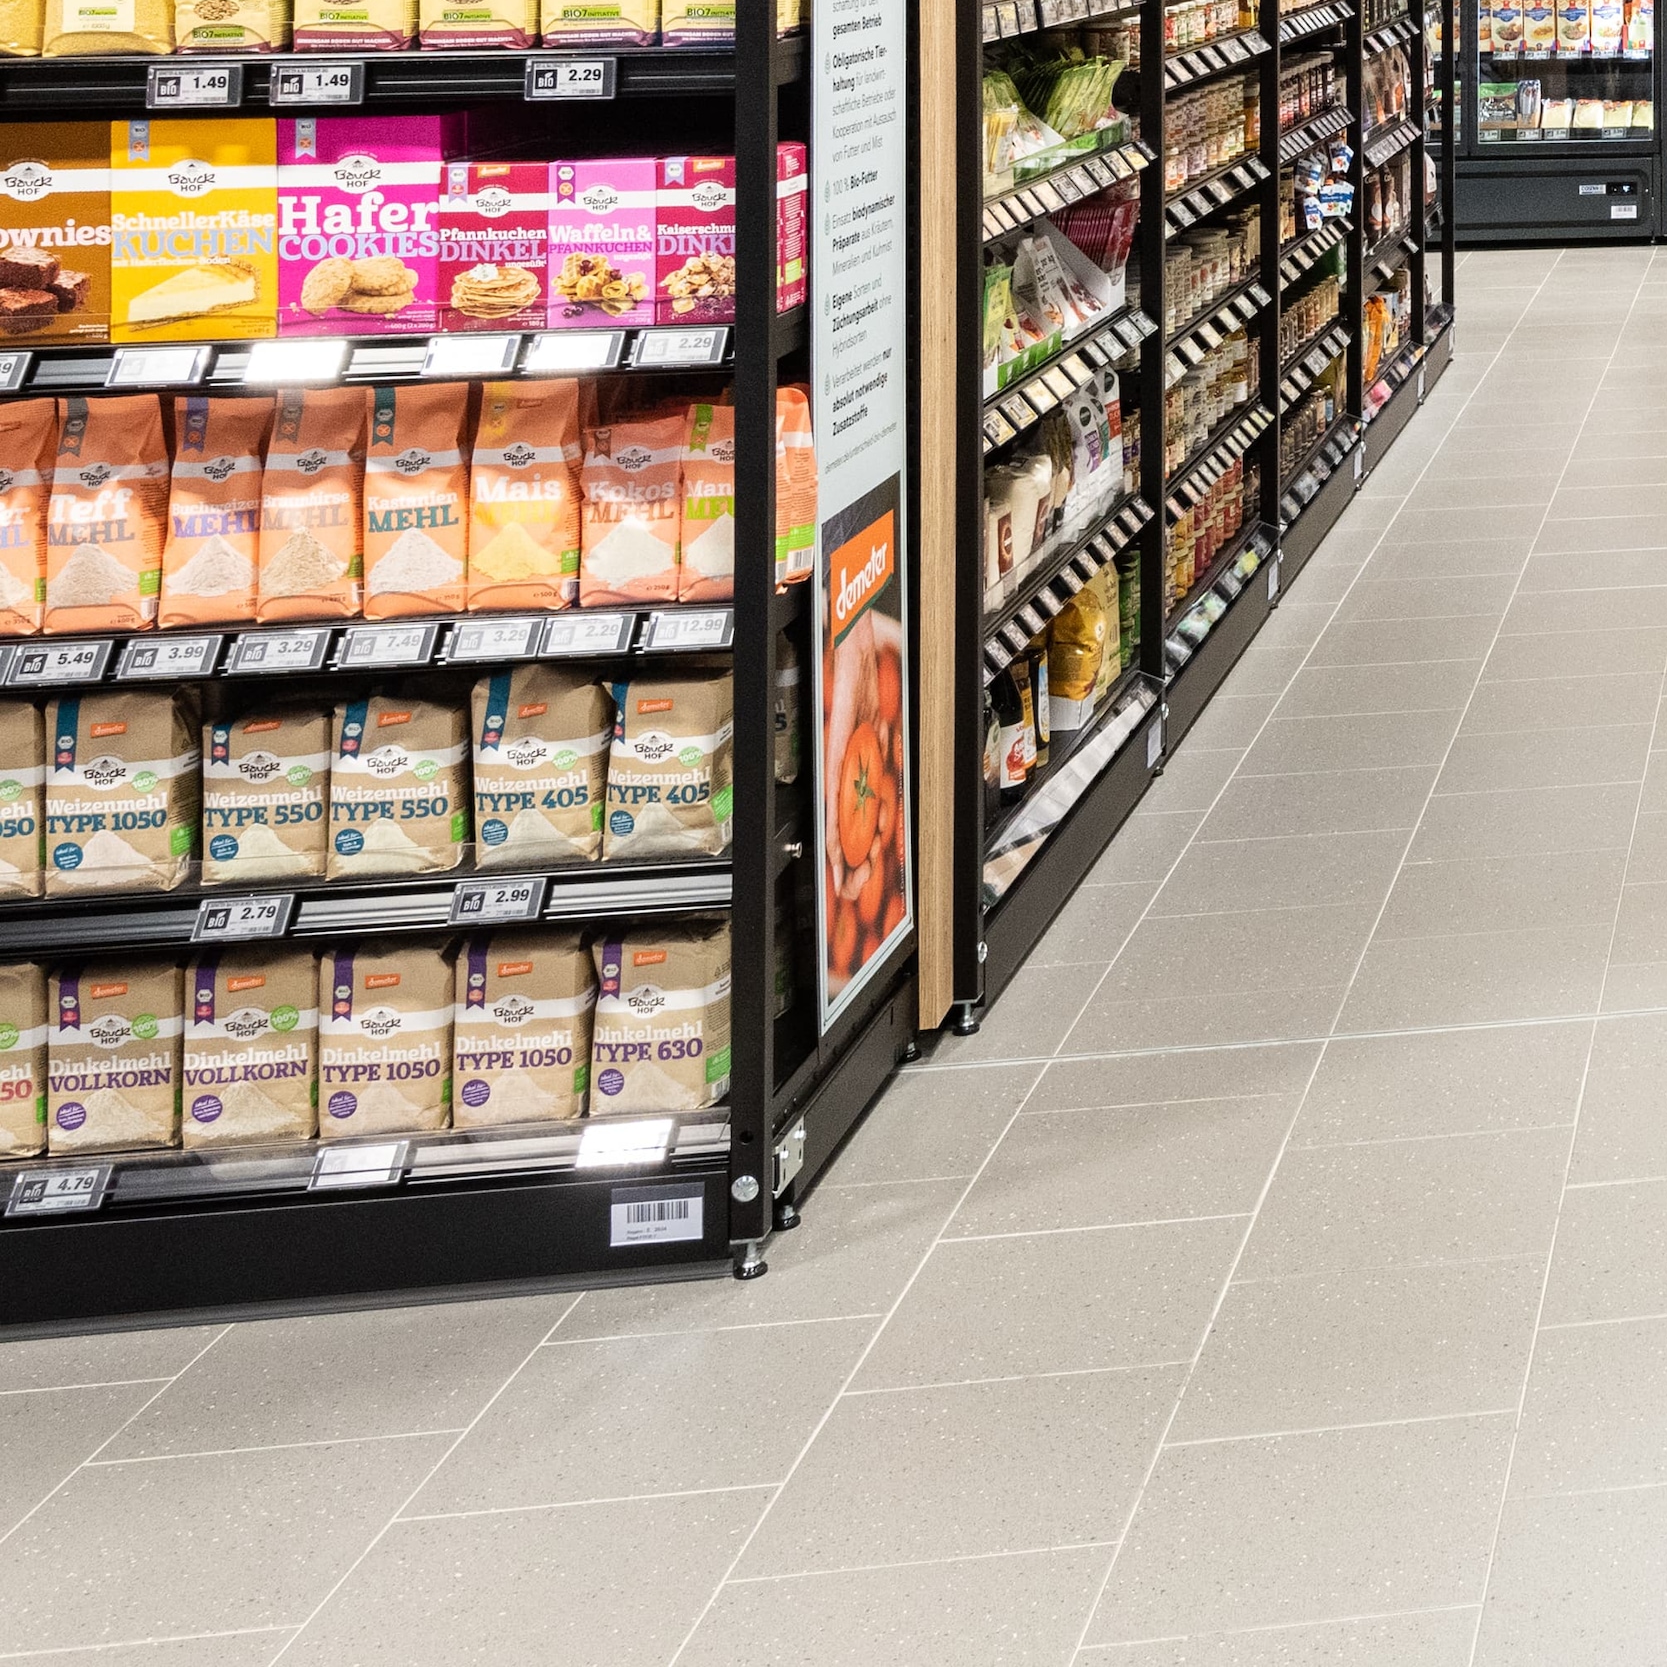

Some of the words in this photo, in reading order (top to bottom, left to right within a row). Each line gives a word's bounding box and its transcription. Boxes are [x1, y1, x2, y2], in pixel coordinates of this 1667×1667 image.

[192, 75, 227, 90] 1.49
[315, 74, 349, 88] 1.49
[568, 68, 601, 82] 2.29
[180, 183, 205, 193] HOF
[112, 210, 275, 233] SchnellerKäse
[278, 191, 440, 235] Hafer
[113, 227, 274, 259] KUCHEN
[440, 226, 547, 243] Pfannkuchen
[278, 231, 440, 262] COOKIES
[439, 239, 547, 262] DINKEL
[549, 241, 653, 254] PFANNKUCHEN
[475, 474, 562, 502] Mais
[589, 481, 675, 503] Kokos
[52, 488, 133, 524] Teff
[262, 491, 349, 509] Braunhirse
[173, 509, 259, 538] MEHL
[262, 504, 348, 531] MEHL
[48, 518, 136, 547] MEHL
[836, 540, 888, 621] demeter
[57, 651, 94, 665] 5.49
[277, 640, 313, 653] 3.29
[47, 792, 167, 814] Weizenmehl
[204, 785, 322, 808] Weizenmehl
[475, 791, 536, 812] TYPE
[541, 786, 589, 809] 405
[47, 813, 106, 835] TYPE
[112, 809, 167, 831] 1050
[205, 806, 268, 829] TYPE
[274, 800, 323, 823] 550
[494, 889, 530, 904] 2.99
[240, 905, 276, 921] 2.79
[456, 1029, 573, 1054] Dinkelmehl
[657, 1038, 703, 1060] 630
[49, 1051, 171, 1076] Dinkelmehl
[518, 1047, 573, 1068] 1050
[49, 1067, 172, 1093] VOLLKORN
[57, 1175, 94, 1192] 4.79
